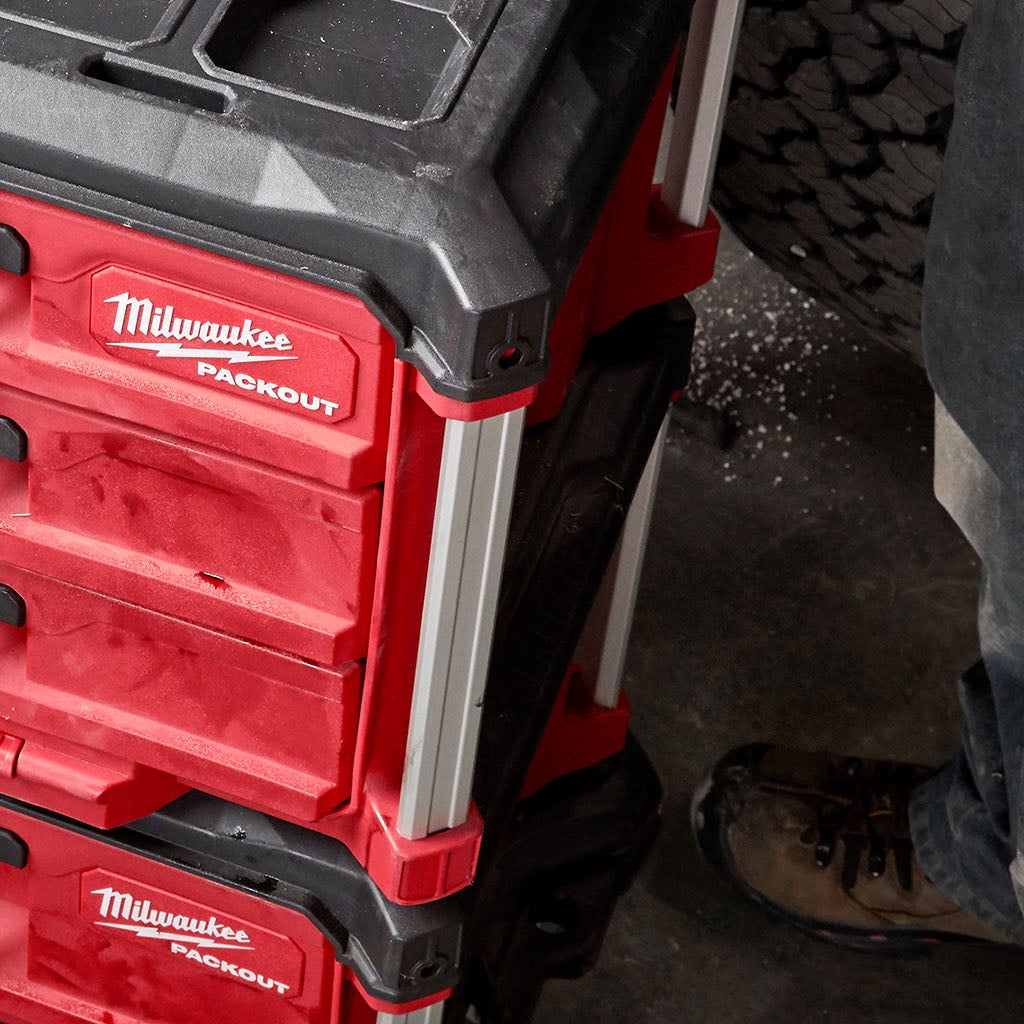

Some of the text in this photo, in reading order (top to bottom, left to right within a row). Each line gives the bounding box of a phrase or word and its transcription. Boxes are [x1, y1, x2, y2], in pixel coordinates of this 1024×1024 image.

[103, 292, 294, 351] Milwaukee
[197, 361, 340, 417] PACKOUT
[90, 887, 251, 943] Milwaukee
[170, 942, 290, 995] PACKOUT
